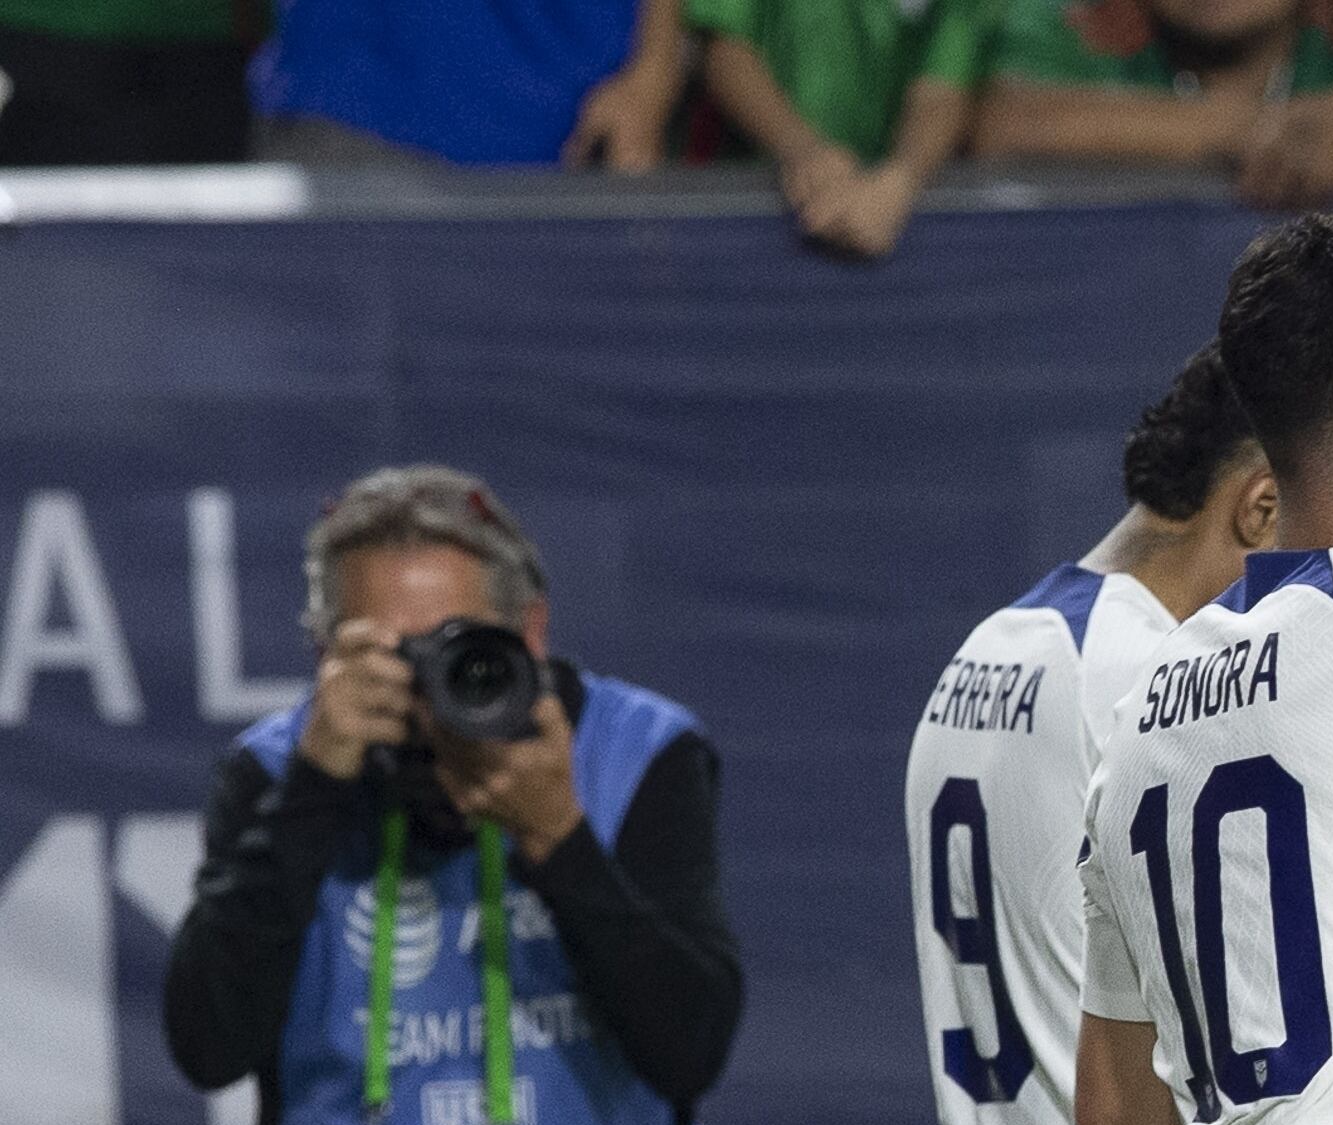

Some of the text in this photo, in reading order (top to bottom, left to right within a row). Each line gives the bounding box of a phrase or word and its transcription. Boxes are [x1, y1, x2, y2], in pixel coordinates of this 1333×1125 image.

[1138, 631, 1281, 735] SONORA
[353, 1007, 462, 1065] EAM
[929, 777, 1035, 1105] 9
[1129, 754, 1333, 1125] 10
